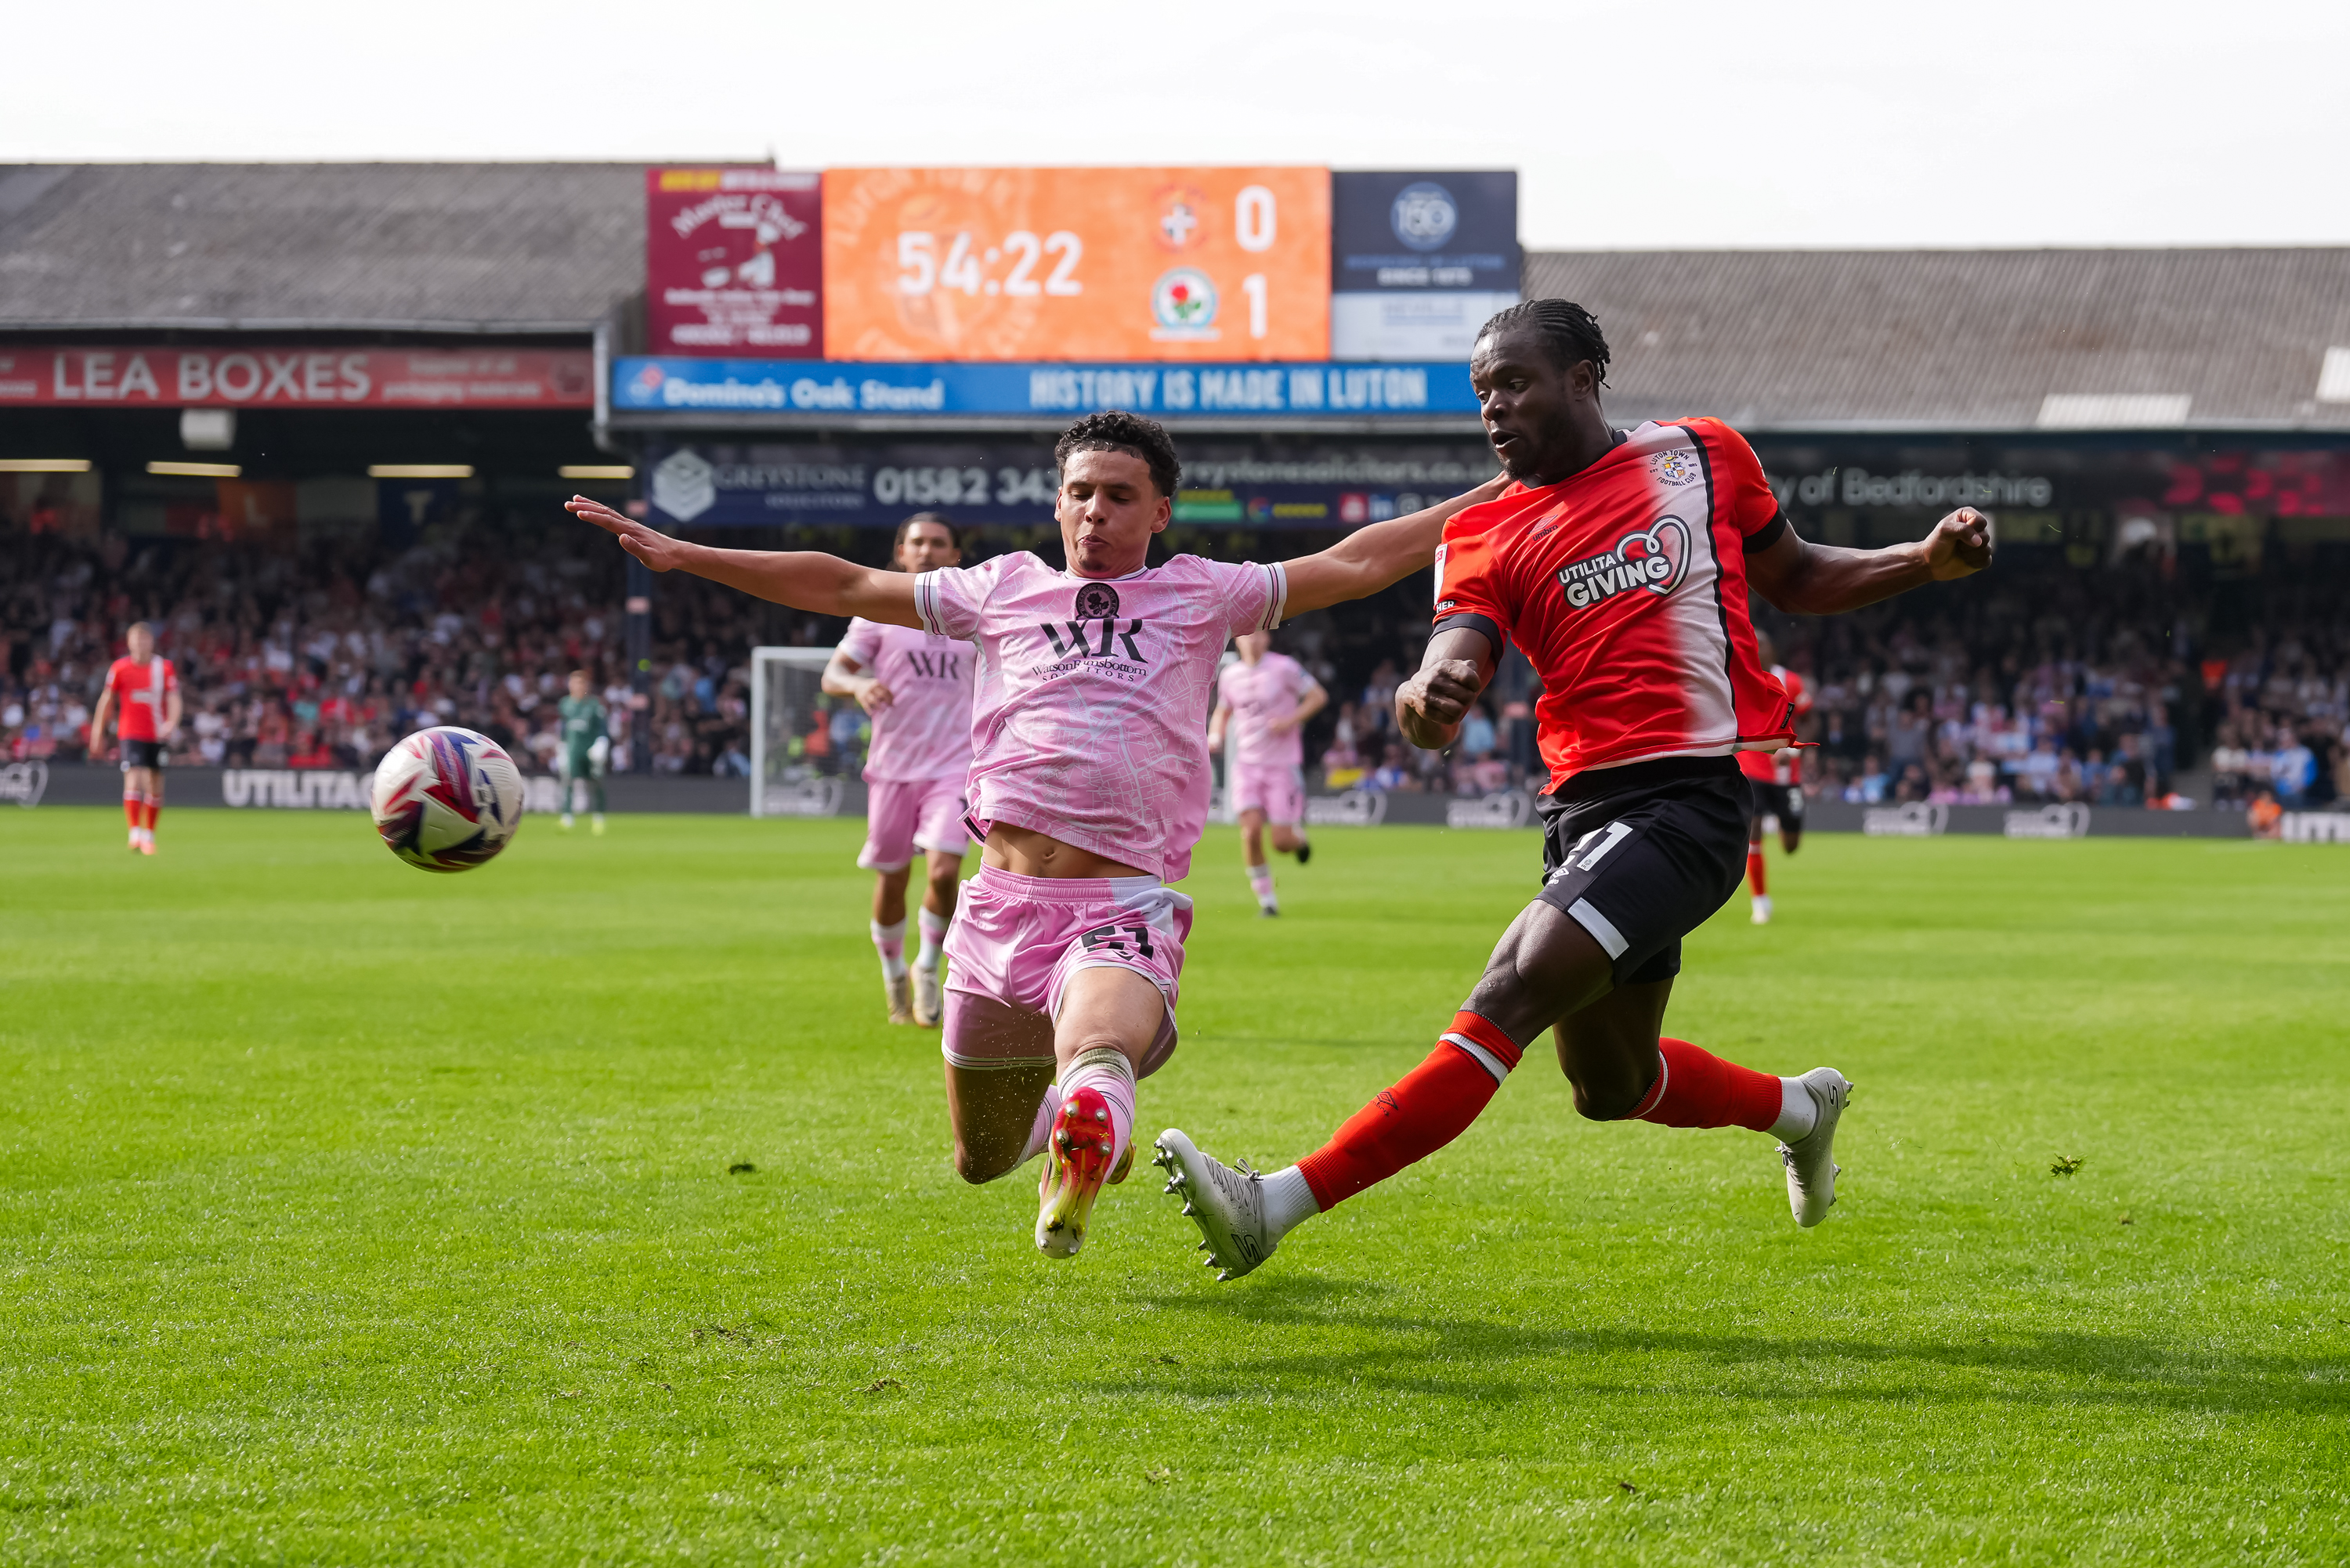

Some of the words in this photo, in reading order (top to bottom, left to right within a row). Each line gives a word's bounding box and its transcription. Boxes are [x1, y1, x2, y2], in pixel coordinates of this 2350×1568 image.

[1235, 185, 1276, 251] 0
[898, 230, 1083, 296] 54:22
[1243, 273, 1266, 339] 1
[53, 354, 160, 400] LEA
[178, 354, 371, 402] BOXES
[663, 378, 785, 408] Domino's
[791, 376, 853, 409] Oak
[861, 378, 944, 410] Stand
[1029, 370, 1157, 410] HISTORY
[1164, 370, 1194, 409] IS
[1199, 370, 1283, 409] MADE
[1289, 368, 1324, 408] IN
[1329, 368, 1426, 409] LUTON
[1650, 450, 1668, 465] LUTON
[1669, 450, 1690, 461] TOWN
[873, 468, 989, 505] 01582
[1657, 476, 1686, 486] FOOTBALL
[1685, 472, 1697, 484] CLUB
[1799, 468, 1835, 506] of
[1842, 468, 2052, 507] Bedfordshire
[1532, 524, 1559, 542] umbro
[1559, 553, 1617, 584] UTILITA
[1567, 556, 1669, 607] GIVING
[1040, 619, 1148, 663] WR
[907, 650, 960, 680] WR
